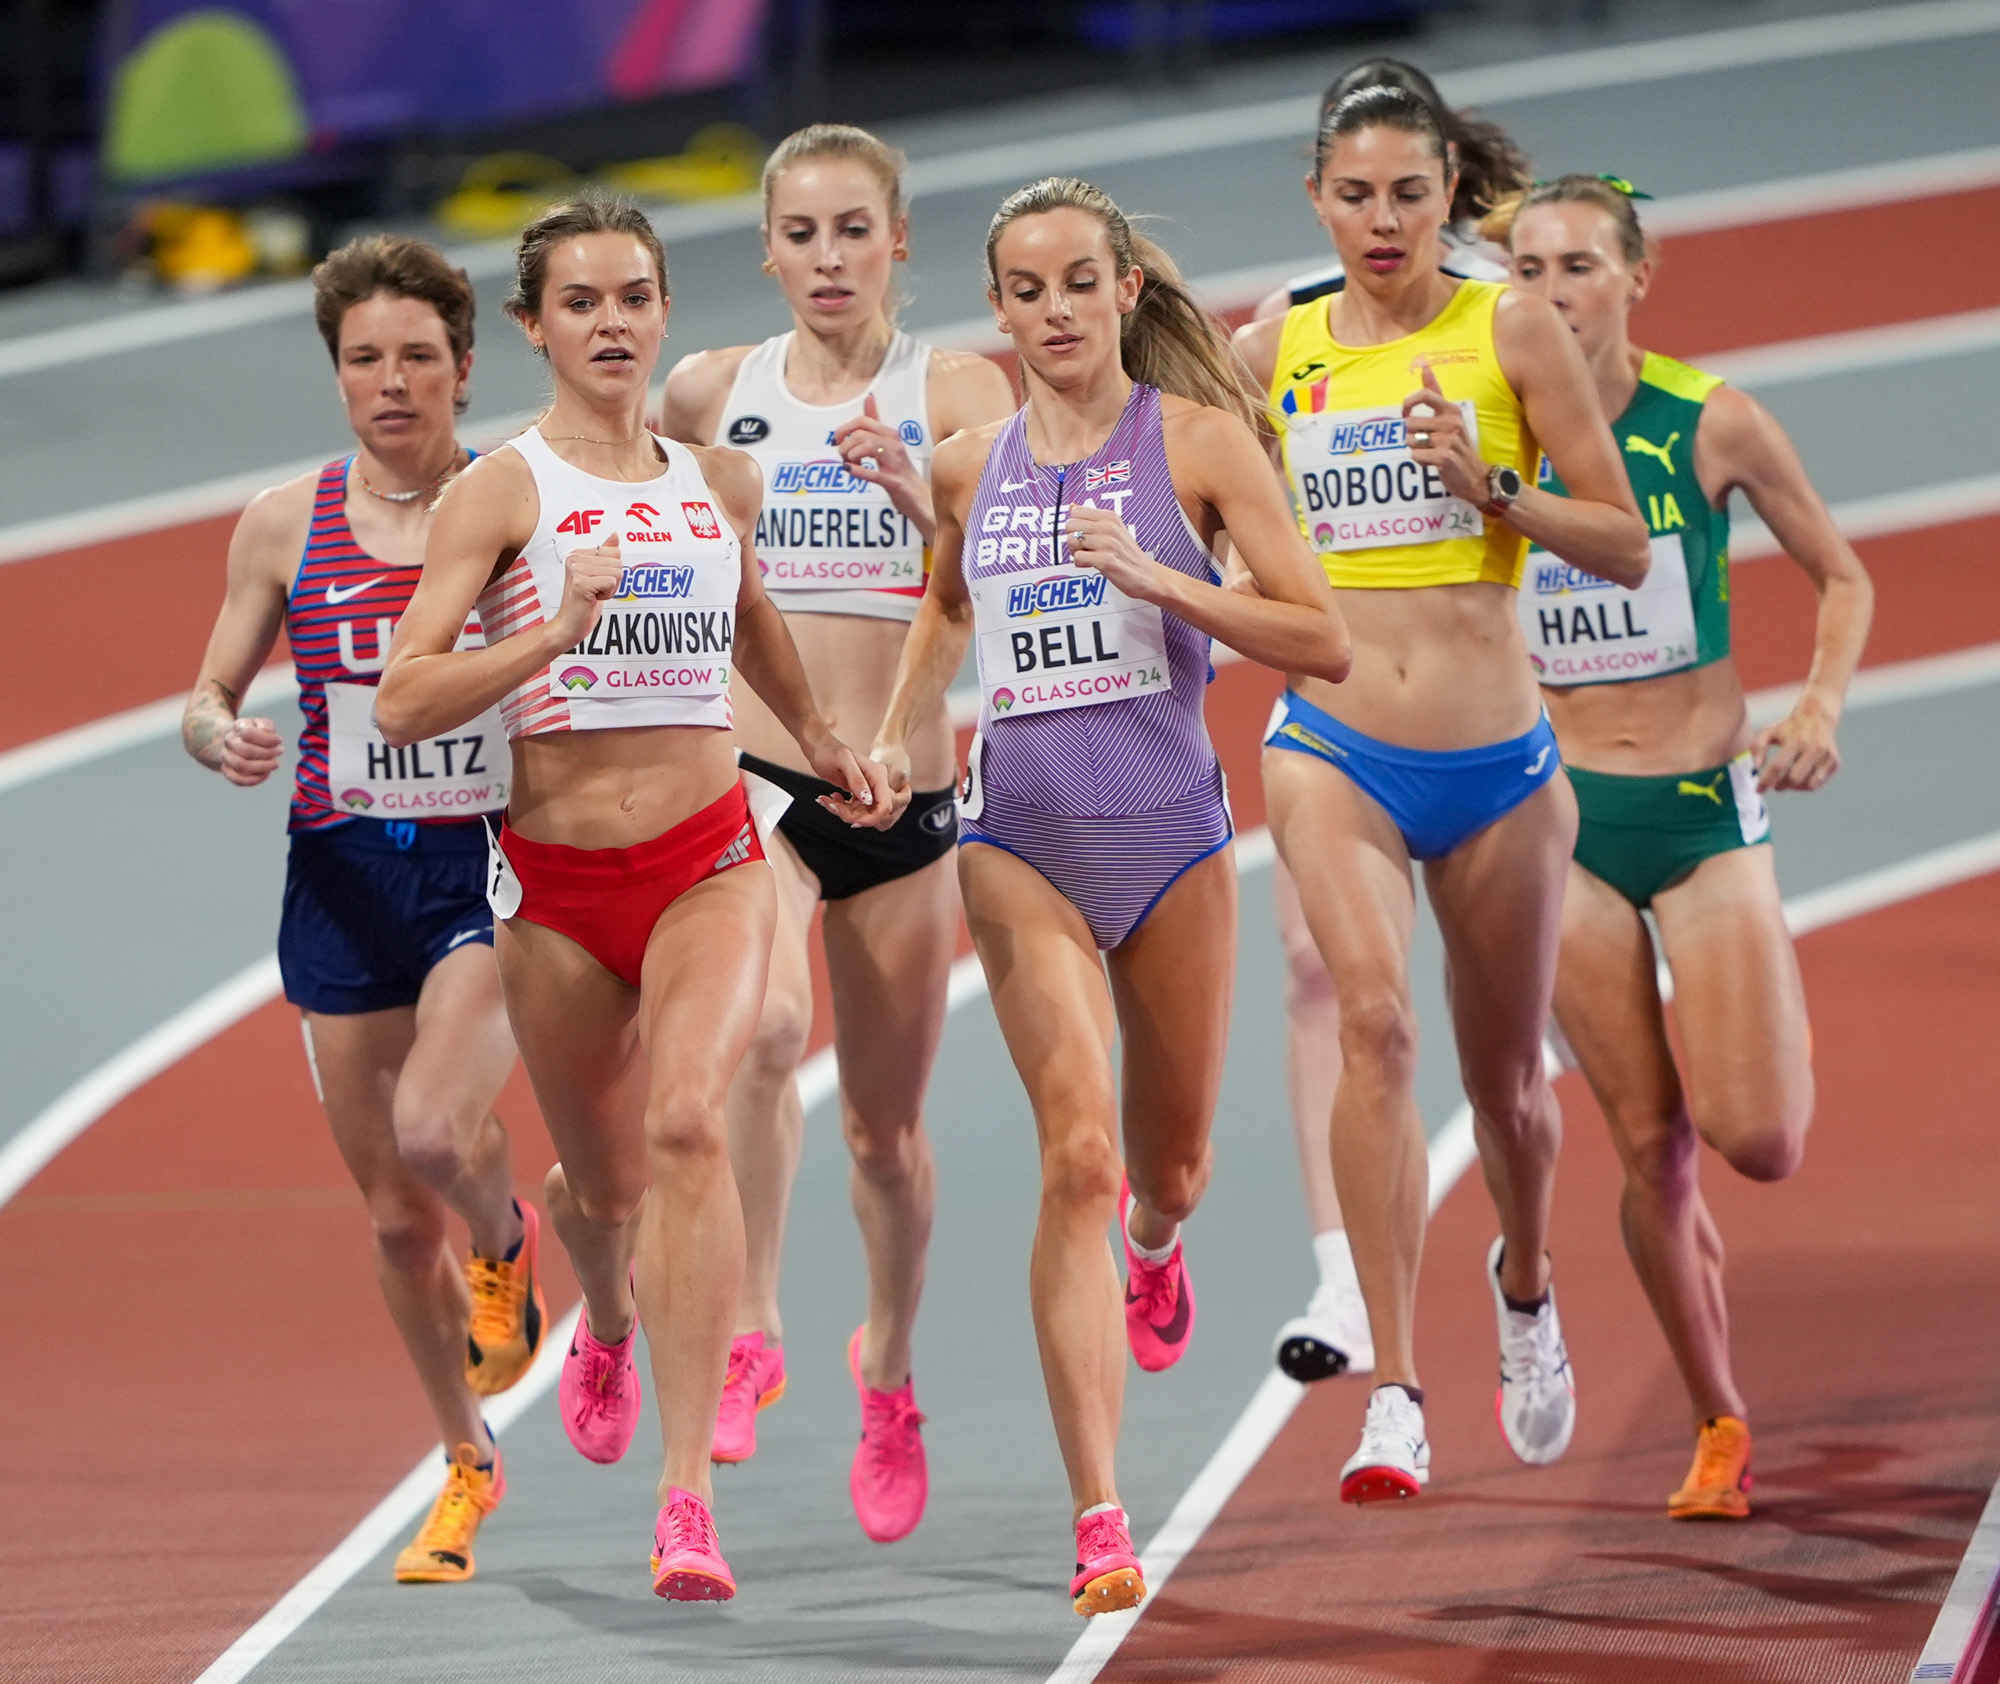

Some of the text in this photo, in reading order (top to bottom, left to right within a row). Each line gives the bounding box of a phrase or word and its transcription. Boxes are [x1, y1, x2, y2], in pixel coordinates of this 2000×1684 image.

[1330, 418, 1408, 454] HI-CHE
[1303, 461, 1452, 511] BOBOCE
[557, 510, 604, 535] 4F
[627, 532, 672, 542] ORLEN
[1339, 512, 1474, 540] GLASGOW 24
[775, 561, 914, 578] GLASGOW 24
[1006, 573, 1107, 617] HI-CHEW
[563, 611, 732, 655] ZAKOWSKA
[1539, 601, 1648, 645] HALL
[1011, 620, 1119, 673] BELL
[1553, 645, 1688, 676] GLASGOW 24
[606, 667, 729, 688] GLASGOW 2
[1021, 666, 1162, 704] GLASGOW 24
[367, 734, 487, 780] HILTZ
[382, 783, 510, 809] GLASGOW 2
